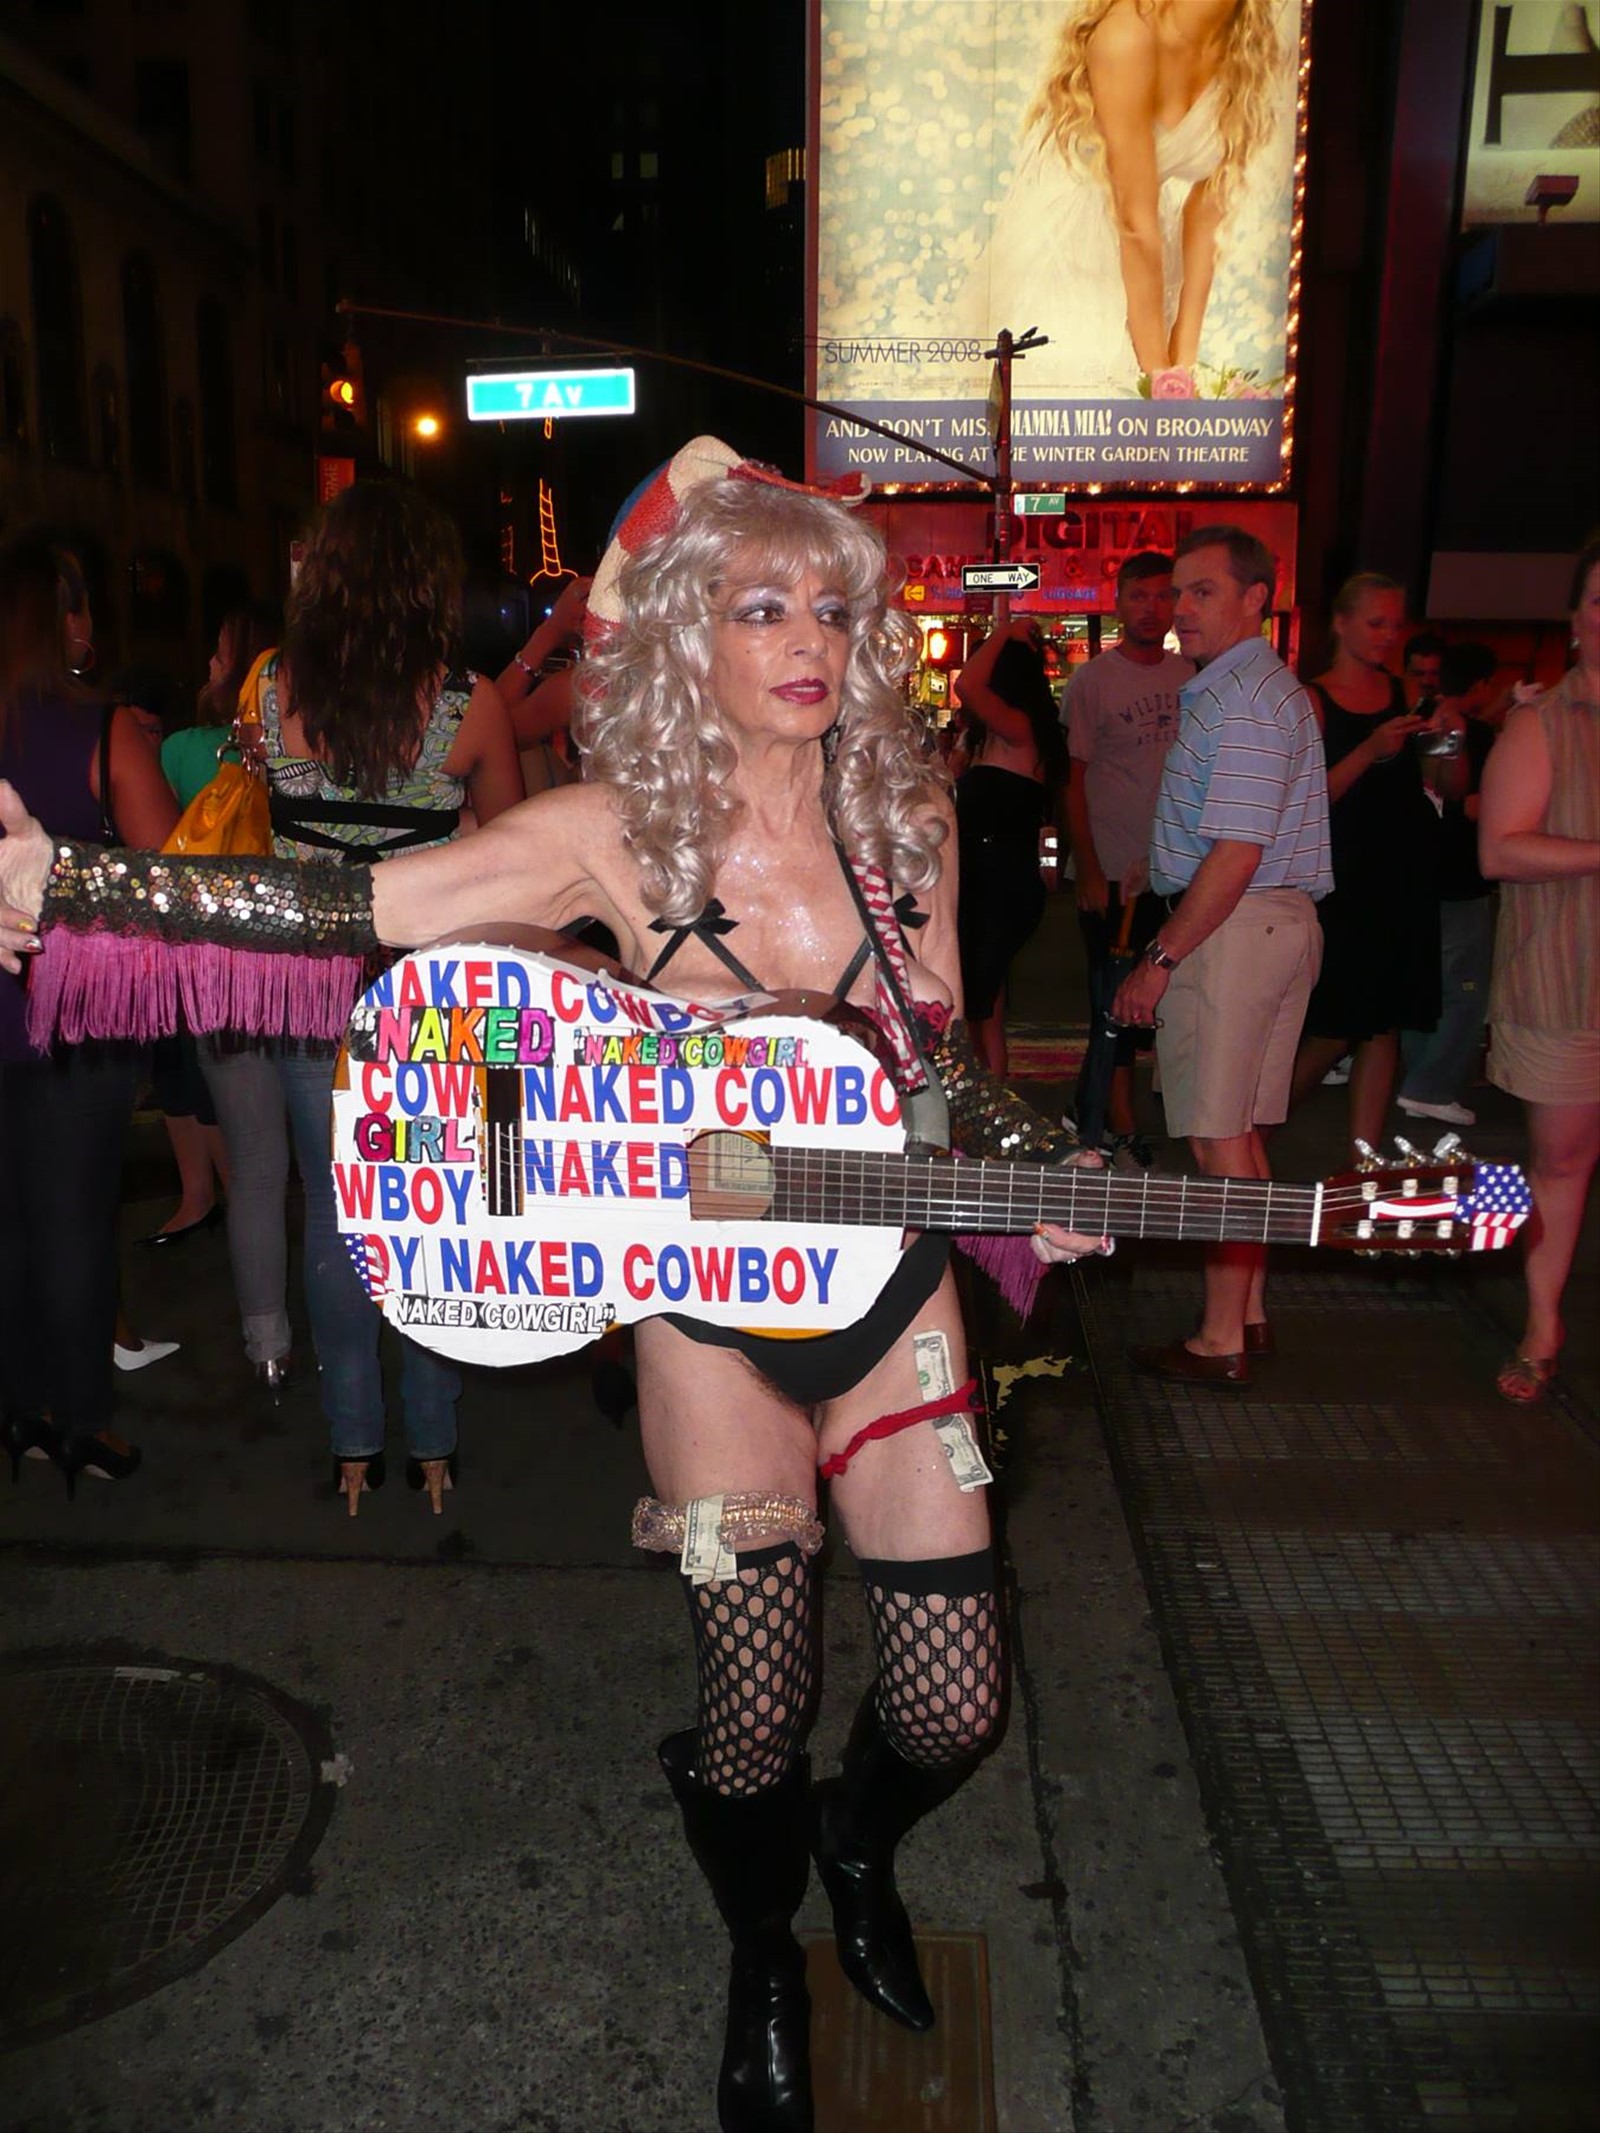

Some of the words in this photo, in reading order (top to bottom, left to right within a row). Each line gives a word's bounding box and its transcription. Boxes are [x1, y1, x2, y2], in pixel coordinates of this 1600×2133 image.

[824, 341, 921, 364] SUMMER
[927, 340, 981, 363] 2008
[515, 382, 534, 409] 7
[826, 419, 870, 438] AND
[878, 418, 944, 438] DON'T
[951, 418, 990, 437] MIS
[1074, 409, 1112, 436] MIA!
[1117, 418, 1149, 437] ON
[1156, 418, 1274, 437] BROADWAY
[848, 447, 889, 463] NOW
[894, 446, 963, 463] PLANG
[968, 446, 990, 462] AT
[1032, 446, 1096, 462] WINTER
[1101, 446, 1170, 462] GARDEN
[1177, 446, 1249, 462] THEATRE
[1031, 497, 1041, 512] 7
[972, 573, 994, 585] ONE
[1008, 572, 1030, 583] WAY
[364, 960, 531, 1007] NAKED
[551, 970, 749, 1031] COWBO
[361, 1063, 475, 1118] COW
[524, 1066, 694, 1124] NAKED
[716, 1065, 901, 1127] COWBO
[355, 1113, 475, 1163] GIRL
[334, 1163, 475, 1225] WBOY
[524, 1139, 692, 1199] NAKED
[440, 1238, 605, 1297] NAKED
[623, 1243, 839, 1305] COWBOY
